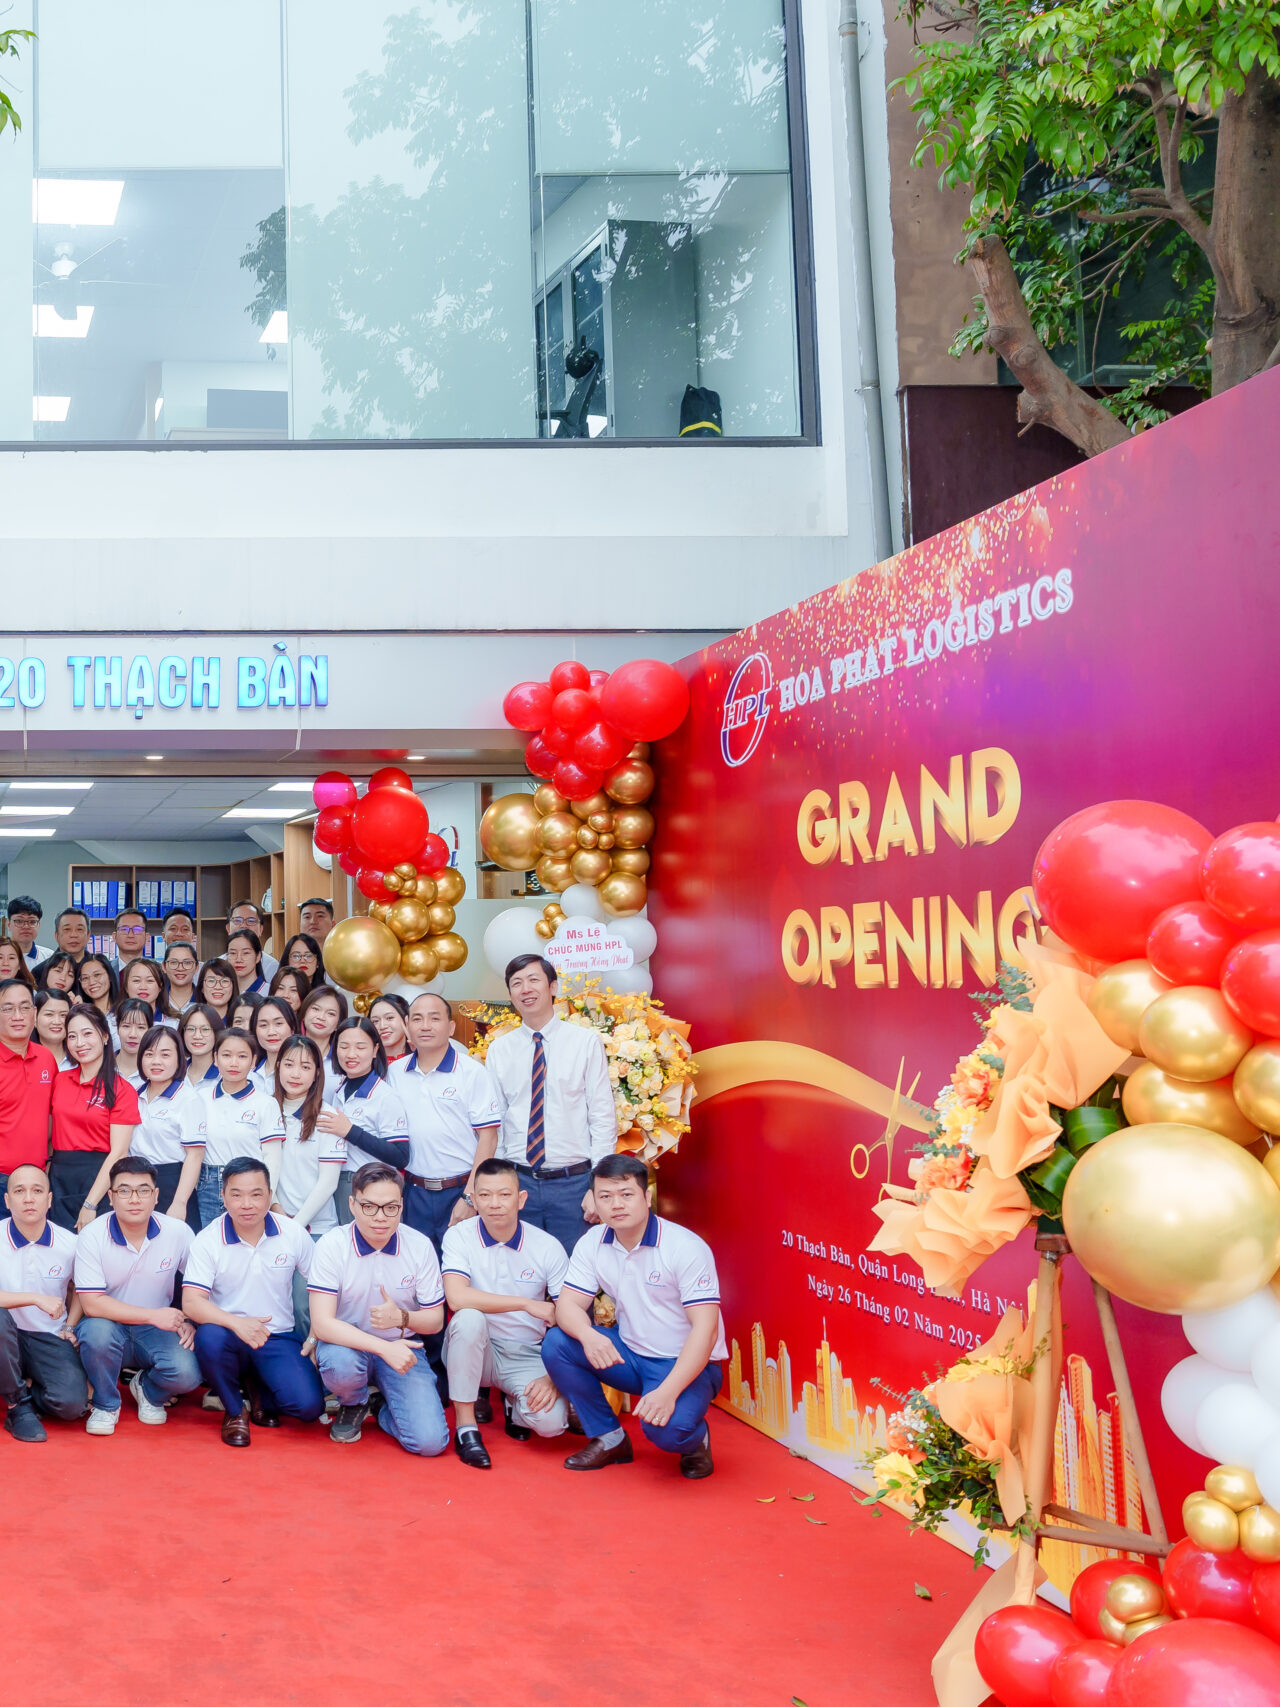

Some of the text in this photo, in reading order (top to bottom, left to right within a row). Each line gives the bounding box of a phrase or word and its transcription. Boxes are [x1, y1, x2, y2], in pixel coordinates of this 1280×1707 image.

[779, 567, 1073, 713] HOA PHAT LOGISTICS
[66, 655, 220, 720] THẠCH
[796, 746, 1022, 867] GRAND
[566, 930, 583, 940] Ms
[605, 940, 622, 949] HPL
[781, 1230, 794, 1247] 20
[796, 1234, 827, 1258] Thạch
[858, 1254, 889, 1279] Quận
[893, 1264, 925, 1295] Long
[971, 1288, 991, 1312] Hà
[807, 1274, 835, 1301] Ngày
[838, 1285, 851, 1304] 26
[854, 1290, 890, 1323] Tháng
[894, 1307, 910, 1327] 02
[913, 1312, 944, 1339] Năm
